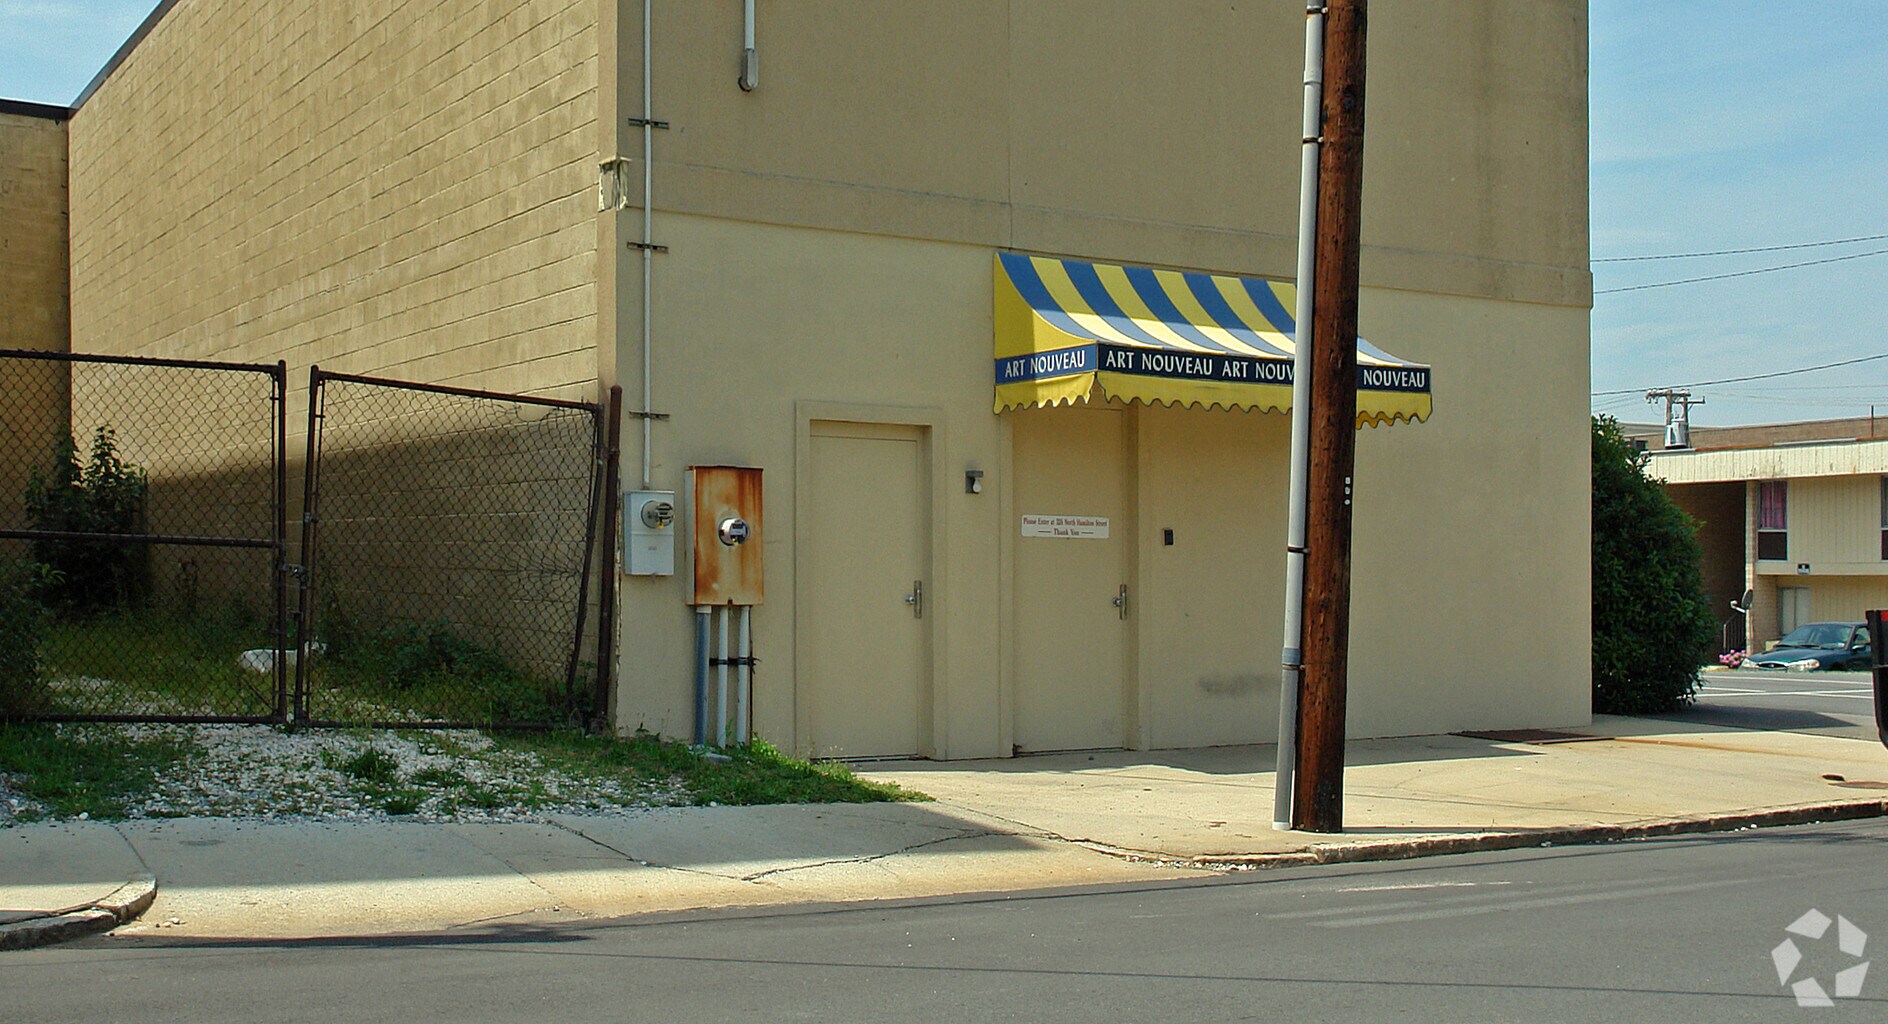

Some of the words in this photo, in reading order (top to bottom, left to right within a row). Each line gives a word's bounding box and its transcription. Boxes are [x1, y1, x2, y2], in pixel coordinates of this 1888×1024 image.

[1005, 359, 1026, 378] ART
[1030, 350, 1085, 374] NOUVEAU
[1105, 350, 1134, 369] ART
[1141, 353, 1213, 375] NOUVEAU
[1222, 360, 1249, 378] ART
[1255, 362, 1296, 381] NOUV
[1363, 369, 1425, 387] NOUVEAU
[1023, 517, 1037, 525] Please
[1038, 517, 1050, 525] Enter
[1064, 518, 1076, 526] North
[1077, 519, 1095, 527] Hamilton
[1095, 519, 1108, 527] Street
[1070, 528, 1080, 536] You
